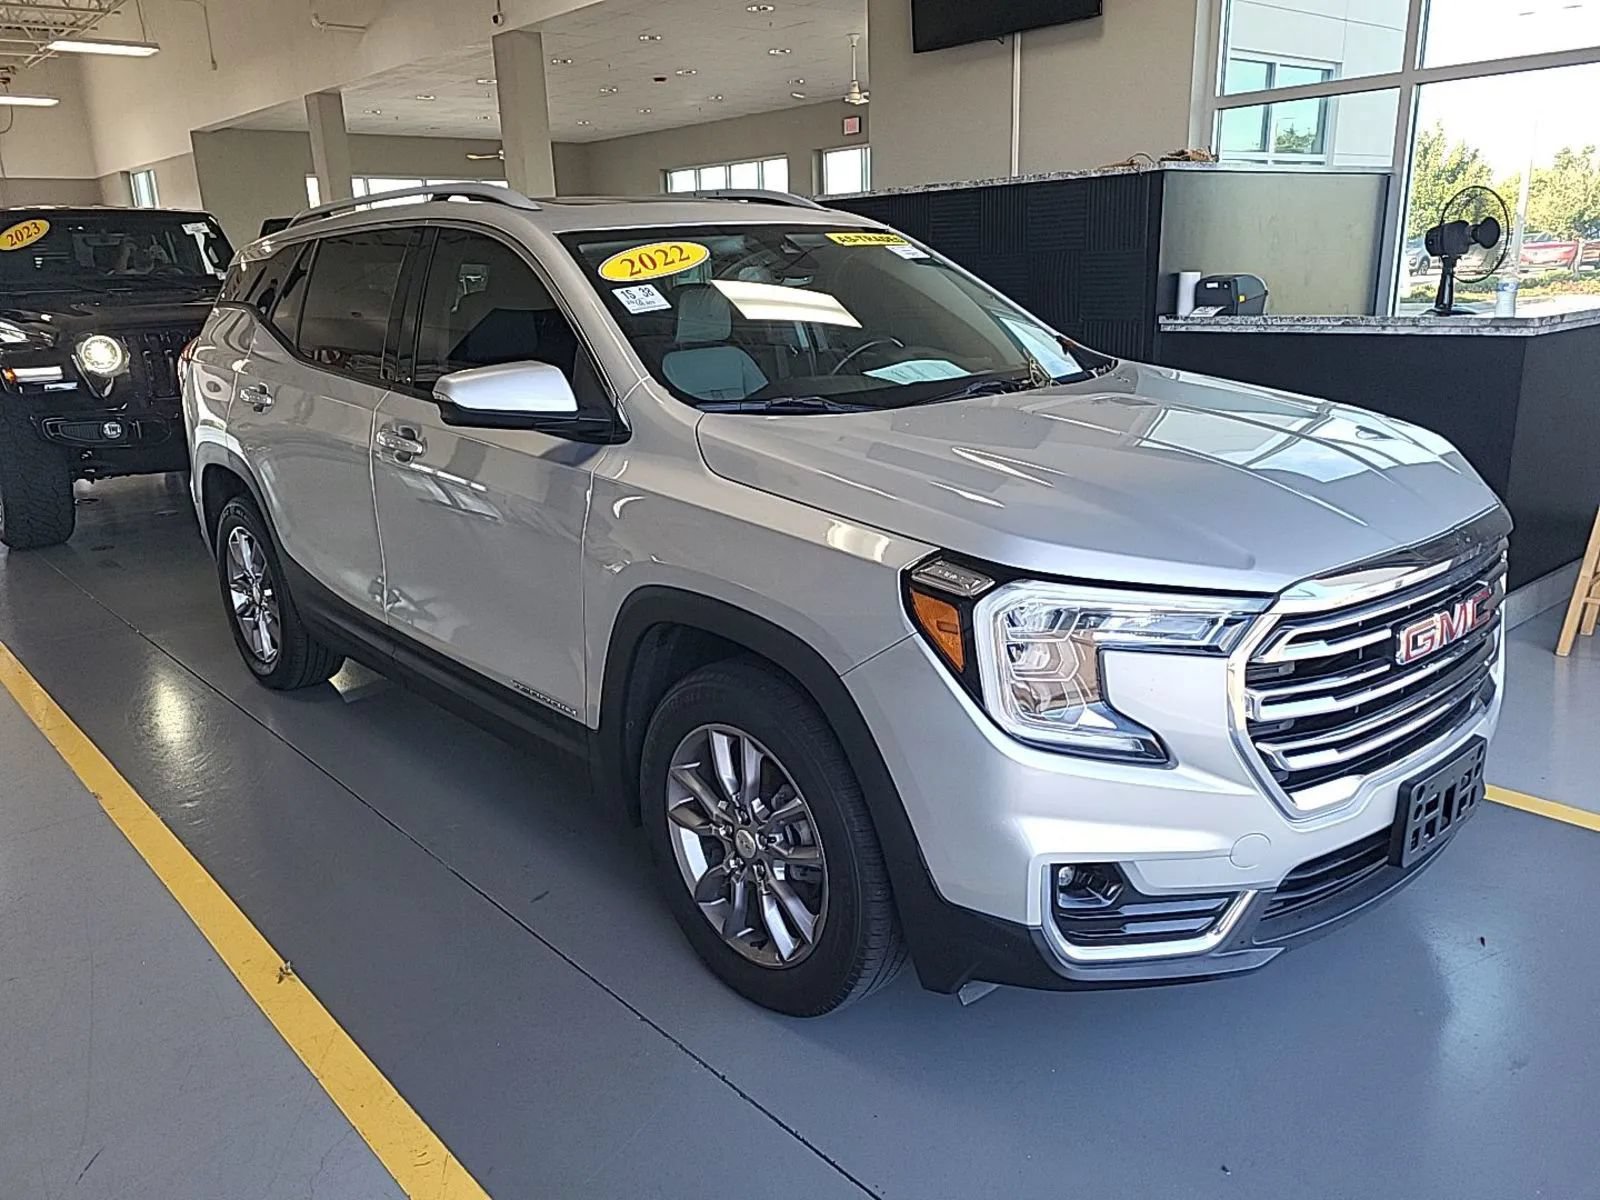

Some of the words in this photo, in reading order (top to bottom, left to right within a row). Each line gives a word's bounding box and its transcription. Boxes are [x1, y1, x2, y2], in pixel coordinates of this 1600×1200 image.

[7, 222, 40, 247] 2023
[620, 245, 690, 277] 2022
[620, 290, 636, 300] 15
[1398, 588, 1492, 664] GMC
